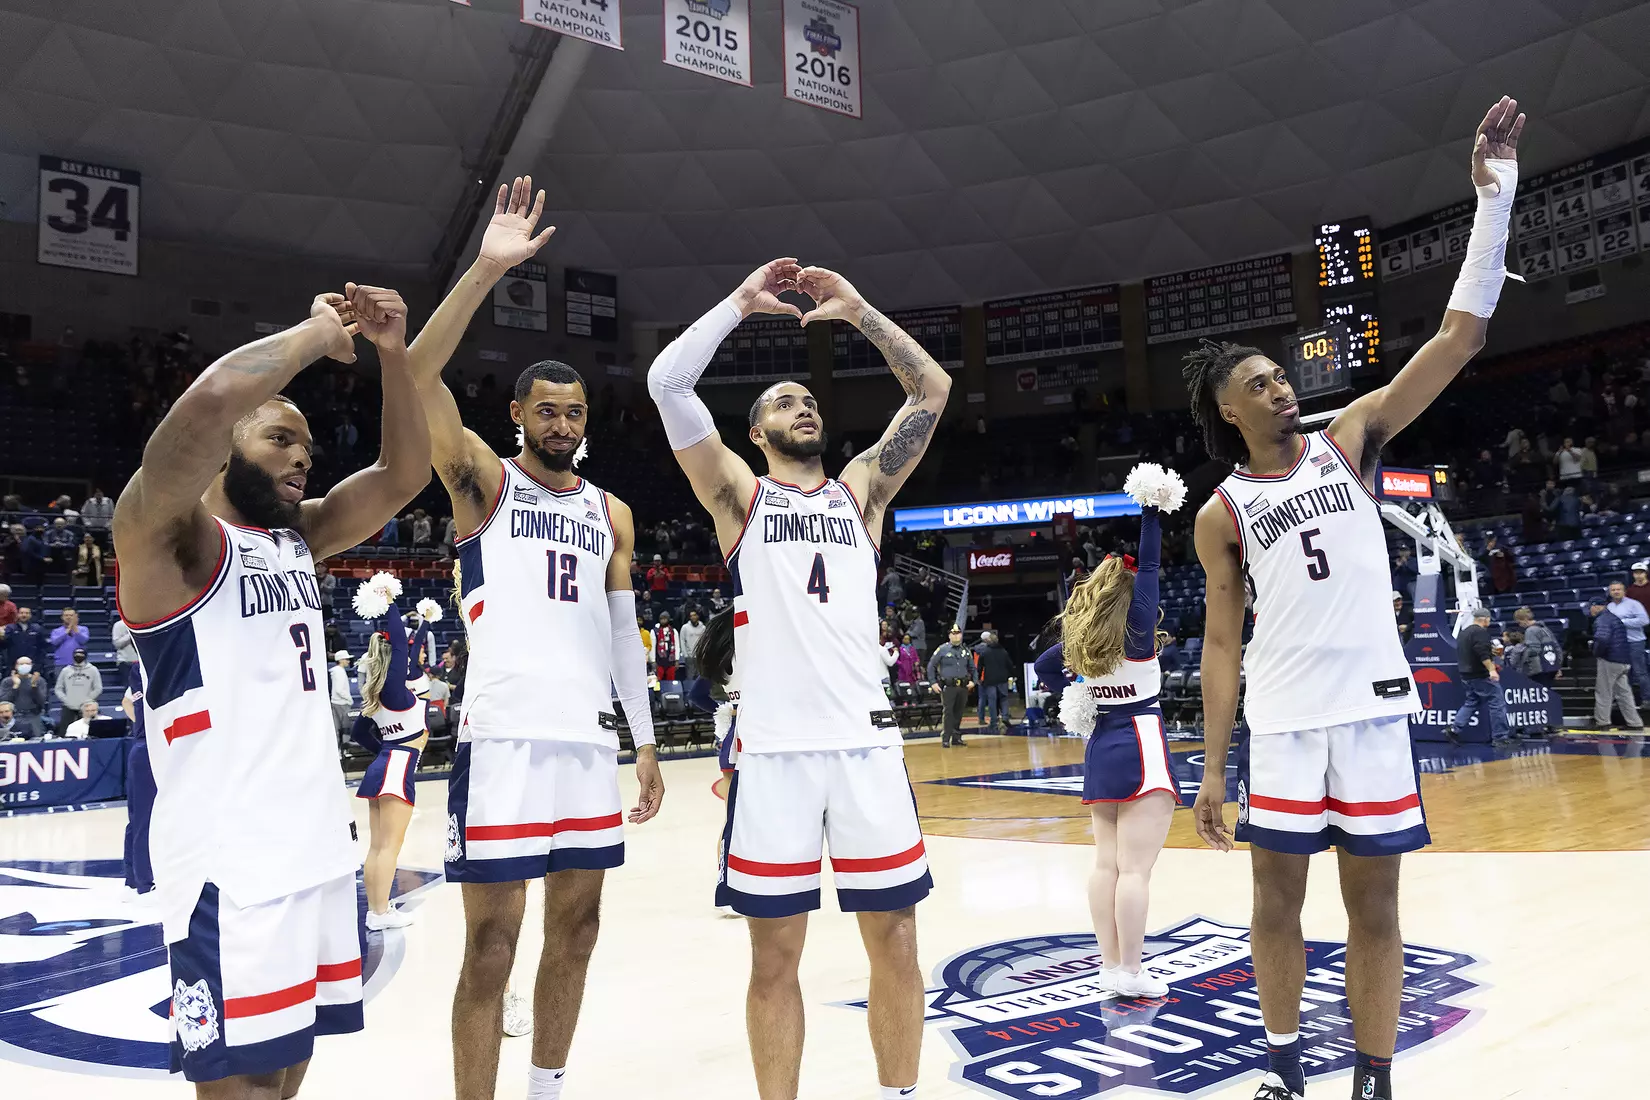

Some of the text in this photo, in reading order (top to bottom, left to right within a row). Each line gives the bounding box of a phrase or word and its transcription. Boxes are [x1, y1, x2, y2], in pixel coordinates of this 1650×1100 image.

[540, 0, 605, 26] NATIONAL
[534, 12, 611, 41] CHAMPIONS
[676, 15, 738, 51] 2015
[680, 41, 737, 65] NATIONAL
[675, 53, 742, 79] CHAMPIONS
[795, 52, 851, 86] 2016
[794, 88, 853, 113] CHAMPIONS
[798, 77, 849, 99] NATIONAL
[61, 160, 121, 180] RAY ALLEN
[47, 178, 131, 241] 34
[1520, 210, 1546, 229] 42
[1558, 197, 1585, 217] 44
[1564, 243, 1586, 262] 13
[1603, 231, 1630, 251] 22
[1152, 256, 1283, 286] NCAA CHAMPIONSHIP
[1524, 253, 1551, 274] 24
[740, 320, 800, 330] CONFERENC
[1321, 462, 1334, 472] BIG
[1321, 463, 1339, 475] EAST
[943, 498, 1095, 526] UCONN WINS!
[1250, 482, 1355, 550] CONNECTICUT
[511, 509, 606, 560] CONNECTICUT
[764, 512, 857, 548] CONNECTICUT
[1300, 528, 1330, 581] 5
[546, 550, 578, 603] 12
[807, 552, 830, 603] 4
[289, 622, 316, 691] 2
[1504, 686, 1549, 705] CHAELS
[1506, 710, 1548, 727] WELERS
[976, 942, 1243, 1013] MEN'S BETBALL
[1191, 968, 1256, 991] 2004
[985, 1016, 1080, 1041] 2014
